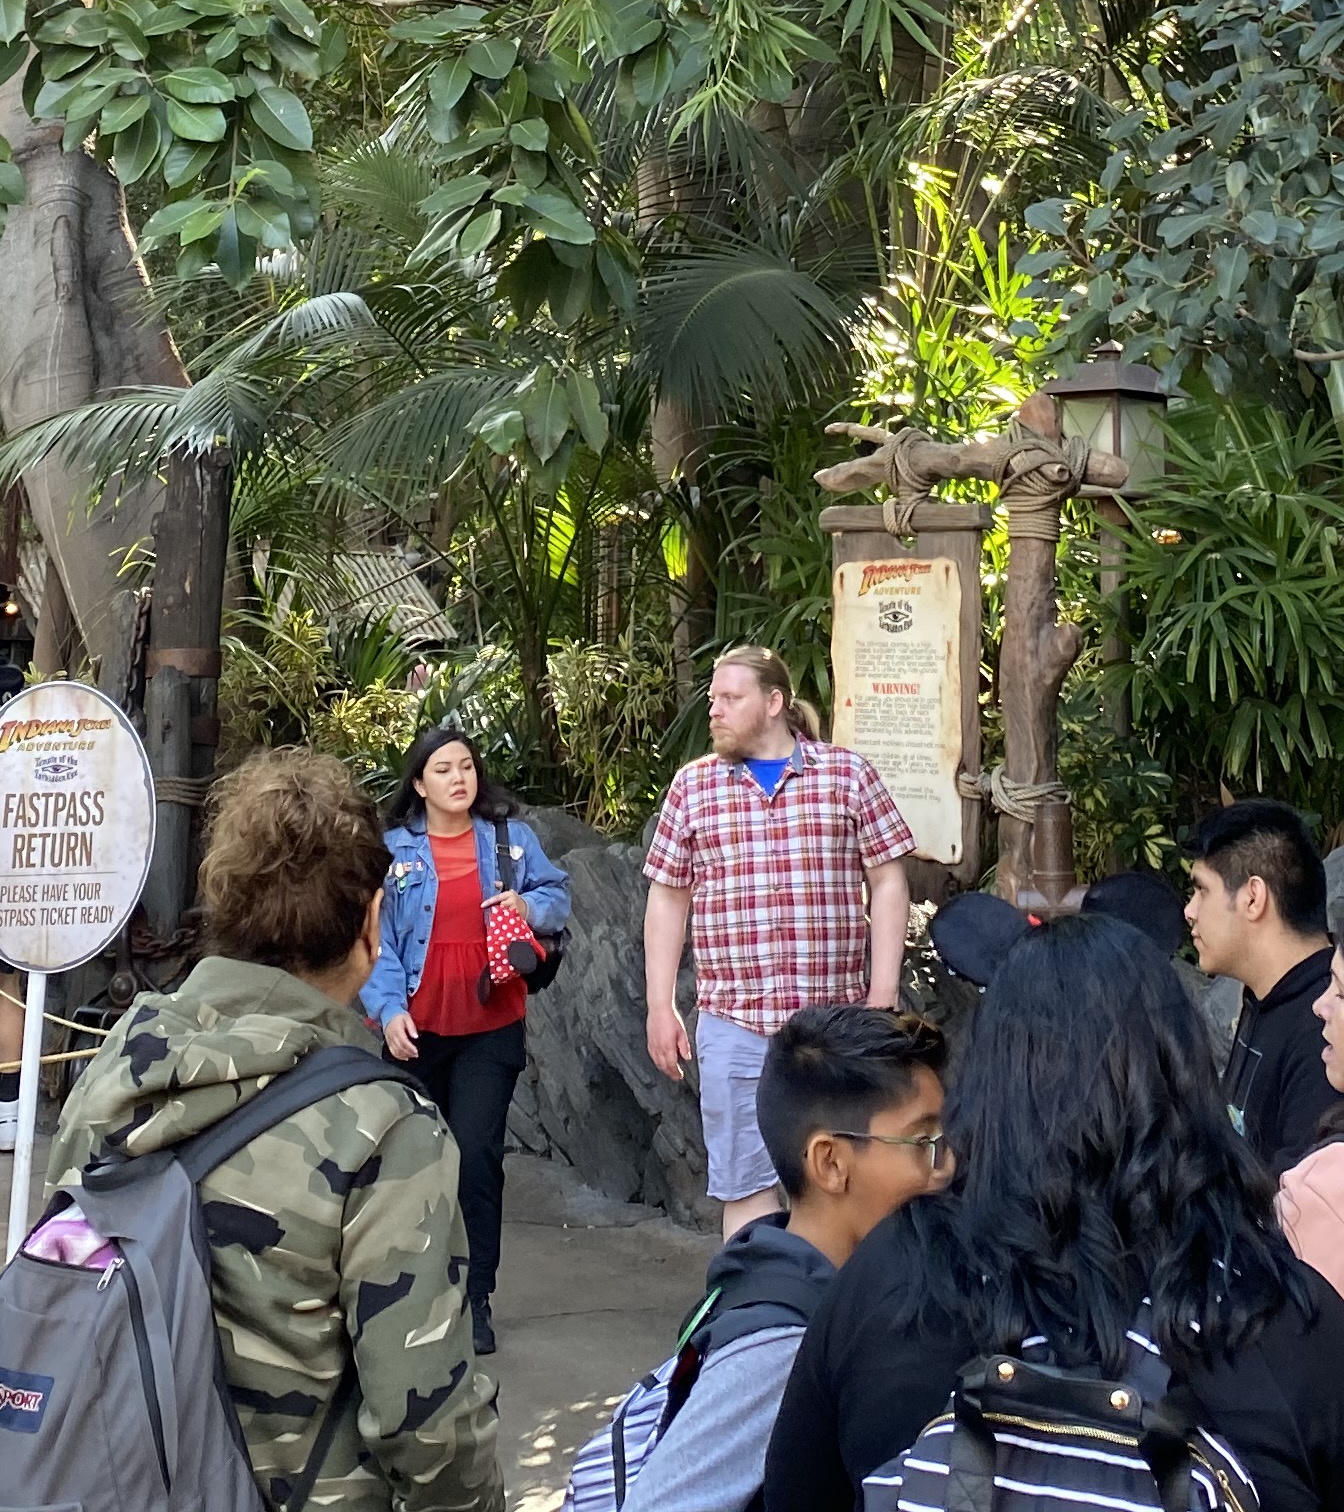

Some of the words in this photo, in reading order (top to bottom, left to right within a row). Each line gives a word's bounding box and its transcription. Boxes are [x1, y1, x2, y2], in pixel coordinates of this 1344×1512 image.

[874, 586, 921, 595] ADVENTURE
[872, 682, 920, 695] WARNING!
[17, 740, 96, 752] ADVENTURE
[2, 791, 105, 828] FASTPASS
[11, 832, 93, 869] RETURN
[0, 885, 38, 904] PLEASE
[41, 883, 69, 902] HAVE
[72, 882, 101, 901] YOUR
[40, 907, 77, 926] TICKET
[80, 905, 115, 924] READY
